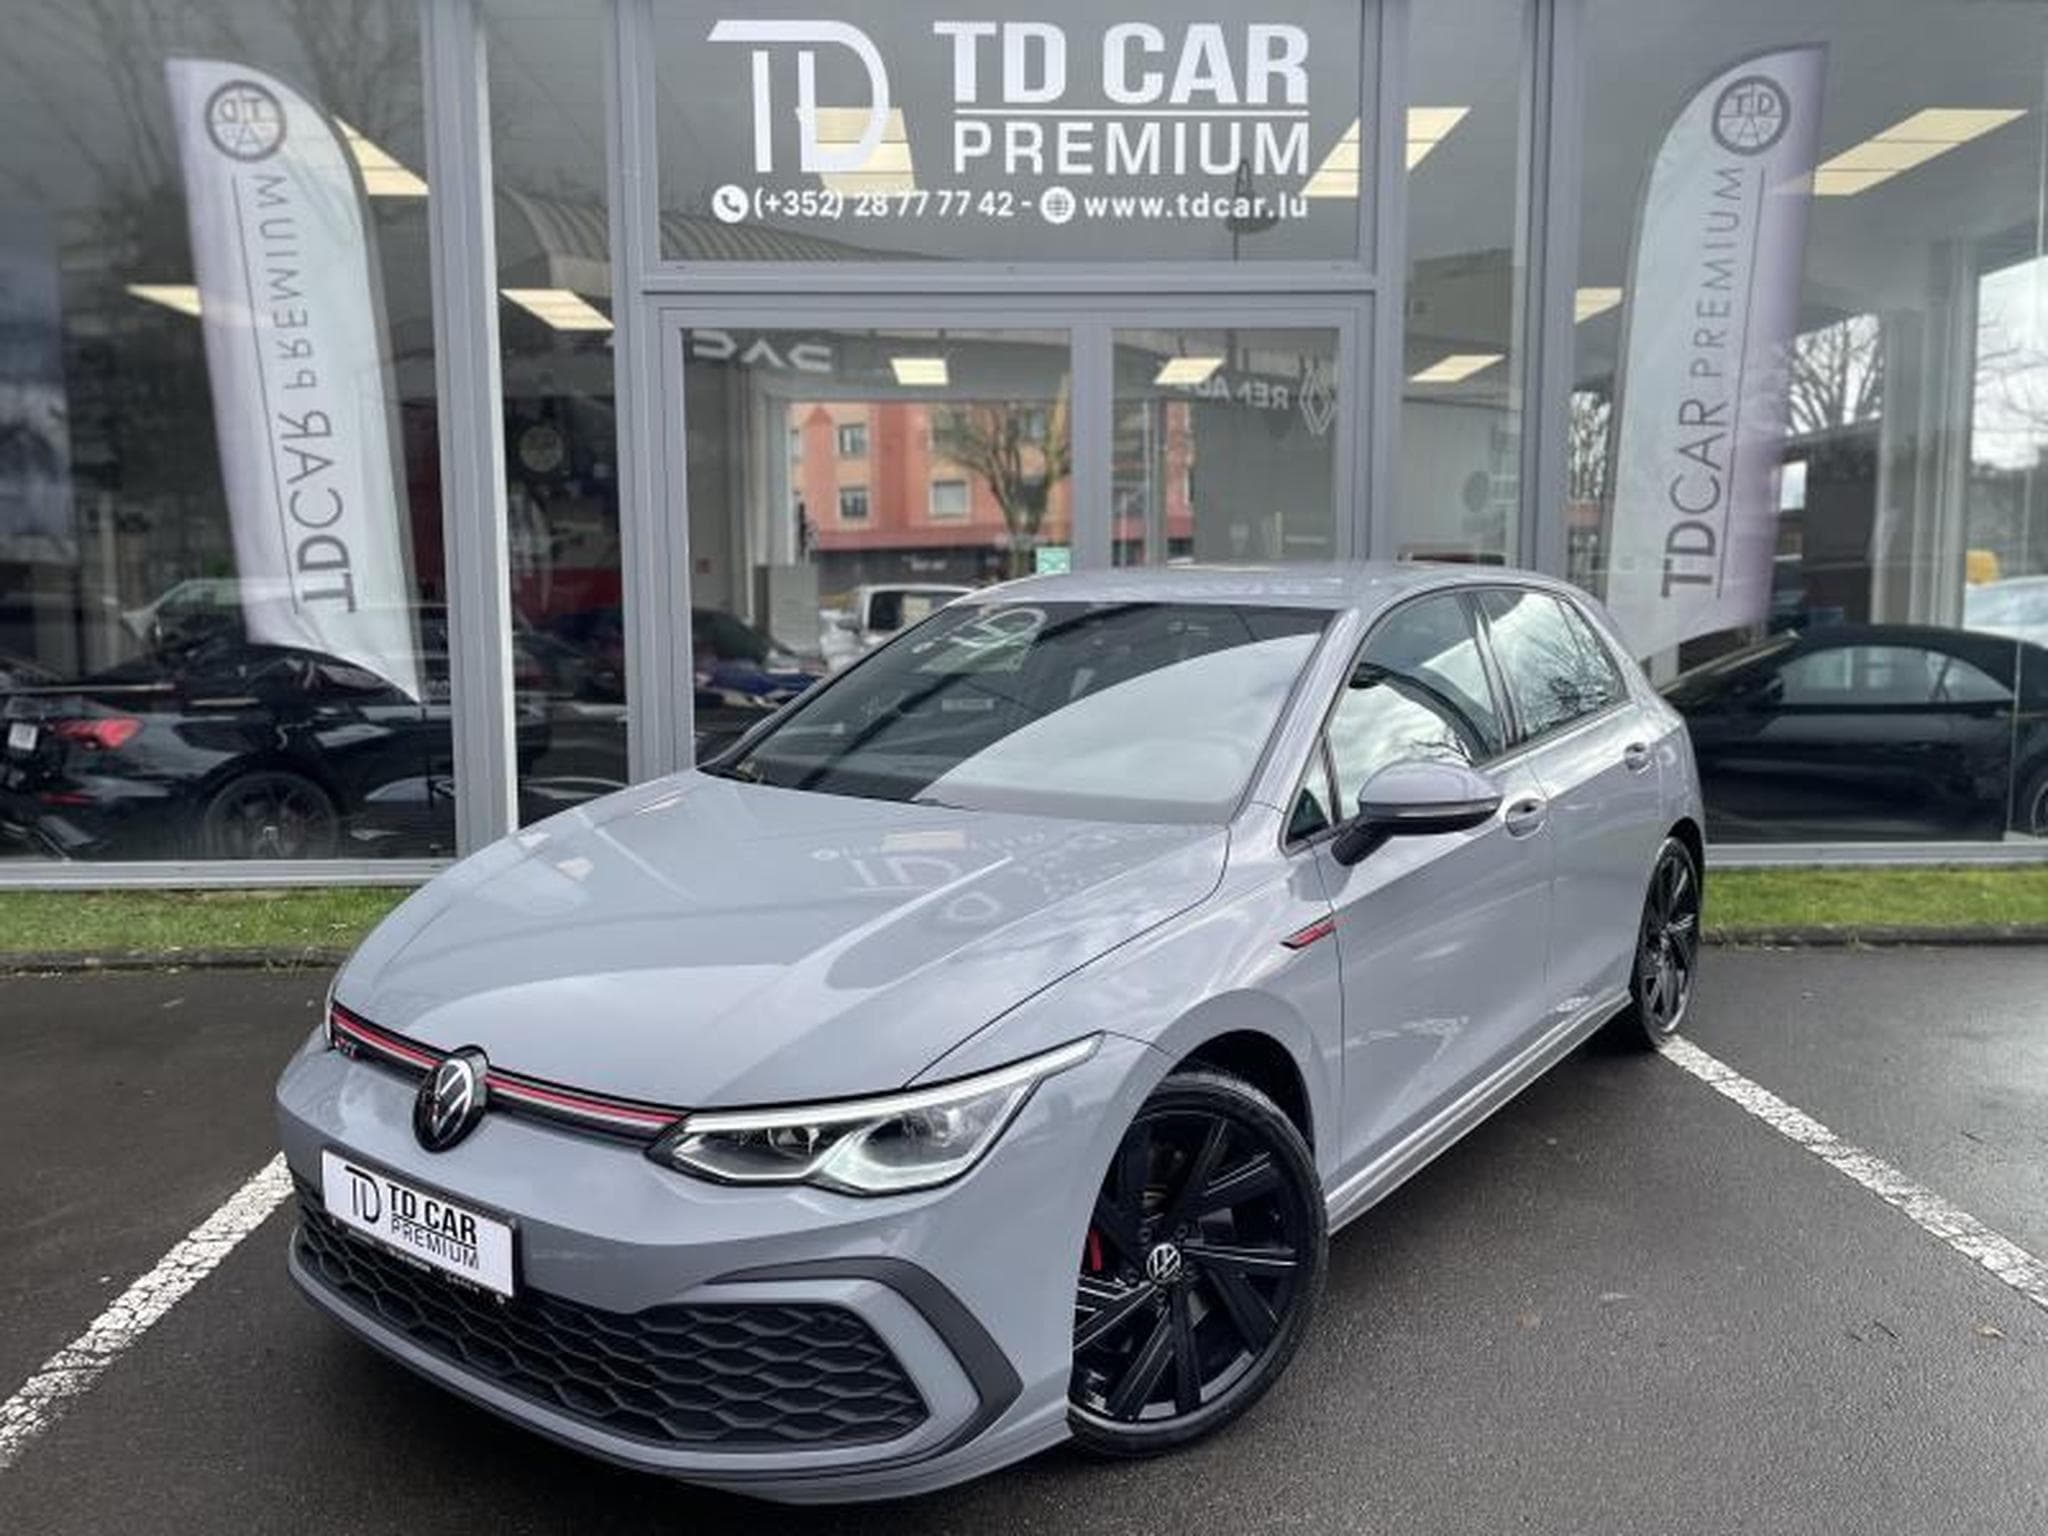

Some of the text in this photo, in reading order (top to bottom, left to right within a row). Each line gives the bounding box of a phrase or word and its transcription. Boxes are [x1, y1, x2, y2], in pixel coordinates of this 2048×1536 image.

[934, 22, 1310, 105] TD CAR
[955, 121, 1310, 175] PREMIUM
[754, 187, 844, 220] (+352)
[853, 190, 889, 217] 28
[897, 190, 930, 216] 77
[936, 190, 972, 216] 77
[977, 190, 1014, 216] 42
[1084, 191, 1308, 218] www.tdcar.lu
[1661, 168, 1743, 598] TDCAR PREMIUM
[386, 1183, 478, 1245] TD CAR
[391, 1216, 480, 1270] PREMIUM
